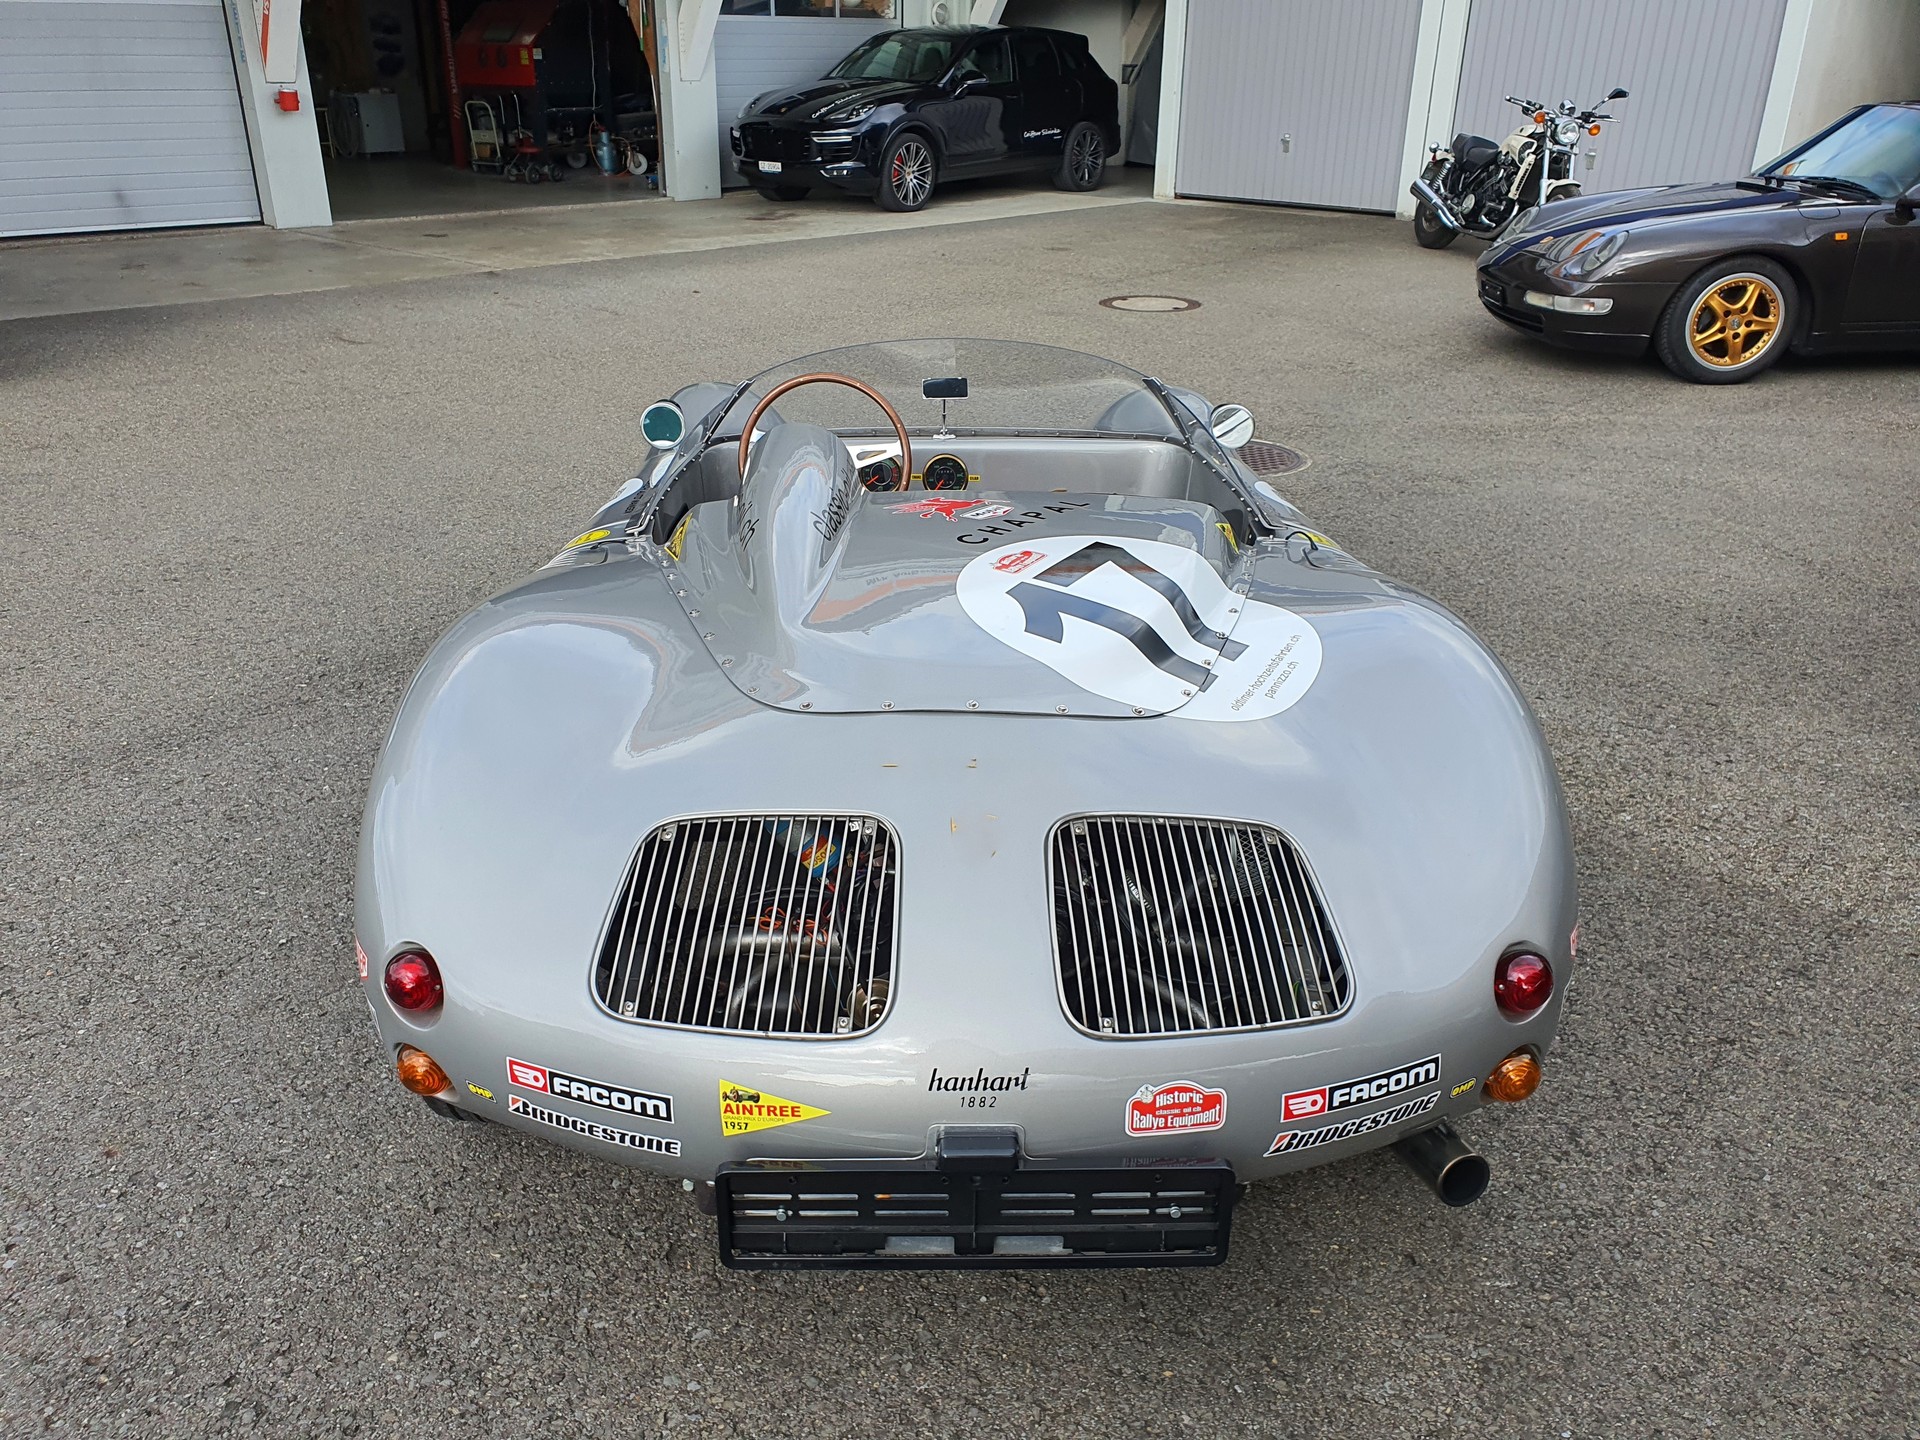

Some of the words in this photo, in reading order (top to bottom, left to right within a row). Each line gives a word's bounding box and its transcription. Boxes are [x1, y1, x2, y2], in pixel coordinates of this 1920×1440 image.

[957, 501, 1090, 545] CHAPAL
[928, 1067, 1031, 1092] hanhart
[1332, 1062, 1436, 1107] FACOM
[1452, 1081, 1475, 1096] OMP
[552, 1076, 668, 1118] FACOM
[961, 1096, 997, 1108] 1882
[1155, 1090, 1204, 1108] Historic
[723, 1103, 801, 1118] AINTREE
[1133, 1109, 1165, 1130] Rallye
[1167, 1103, 1221, 1127] Equipment
[724, 1121, 749, 1131] 1957
